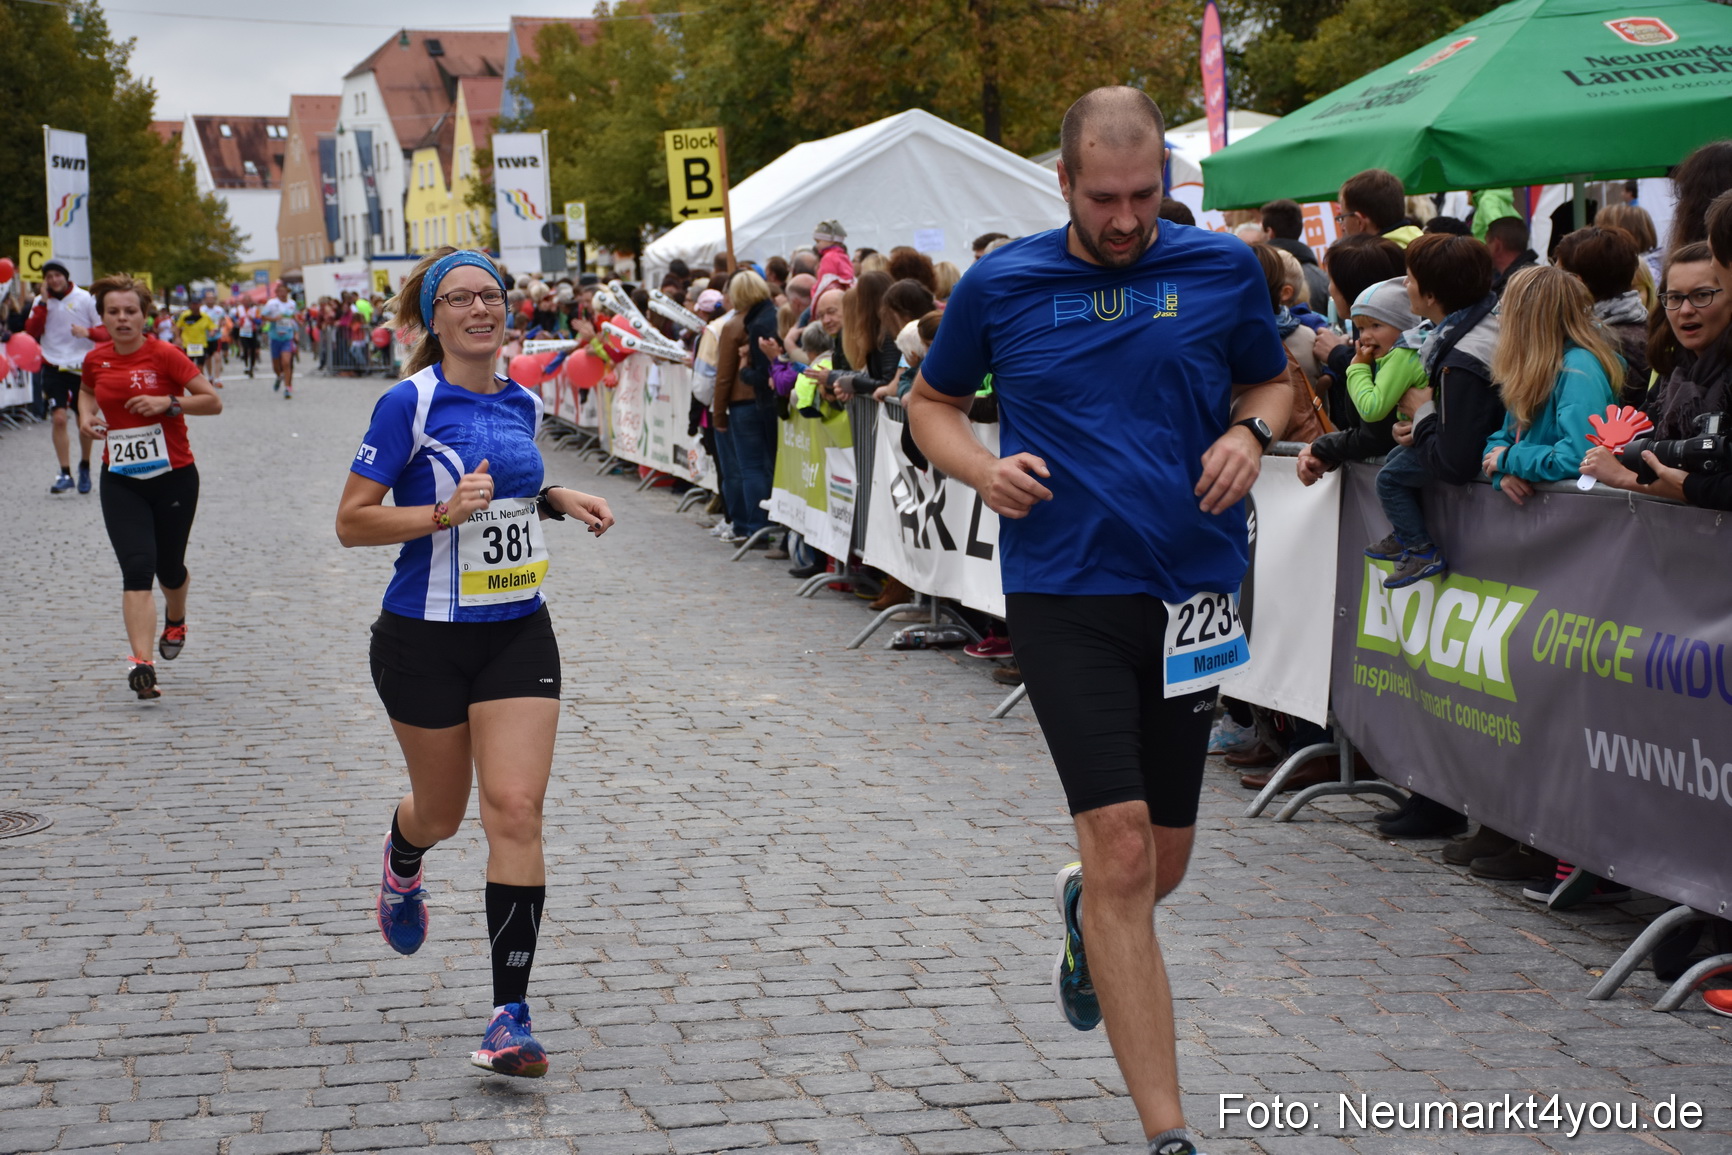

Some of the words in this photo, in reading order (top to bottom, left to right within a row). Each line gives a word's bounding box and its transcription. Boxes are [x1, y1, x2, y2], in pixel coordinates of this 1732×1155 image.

[673, 132, 718, 150] Block
[52, 154, 86, 171] swn
[684, 157, 713, 200] B
[28, 251, 43, 271] C
[1053, 282, 1166, 327] RUN
[1165, 282, 1178, 311] ADDICT
[113, 438, 159, 463] 2461
[467, 511, 498, 523] ARTL
[482, 520, 532, 564] 381
[488, 570, 536, 590] Melanie
[1364, 563, 1524, 683] BOCK
[1193, 645, 1239, 674] Manuel
[1532, 608, 1642, 684] OFFICE
[1353, 655, 1412, 698] inspired
[1455, 703, 1521, 747] concepts
